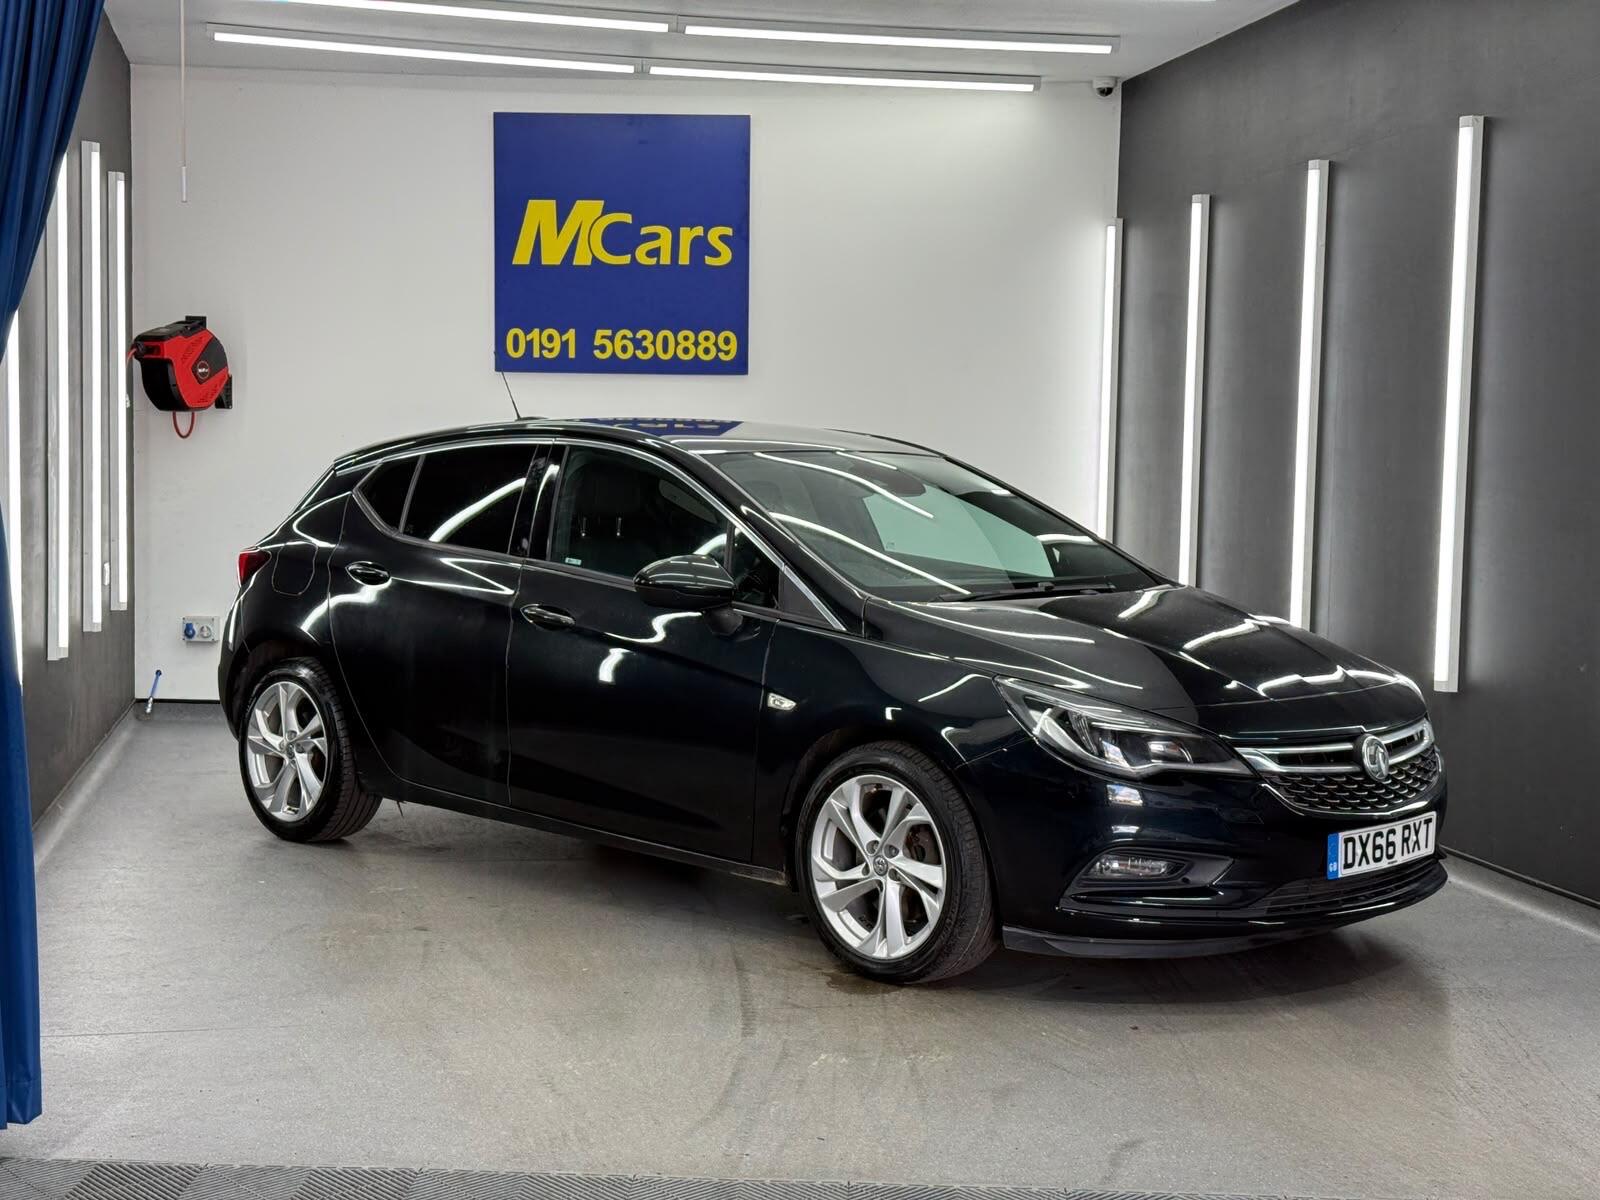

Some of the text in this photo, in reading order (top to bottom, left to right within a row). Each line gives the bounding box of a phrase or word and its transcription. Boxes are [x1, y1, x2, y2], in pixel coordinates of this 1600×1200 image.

[506, 328, 738, 361] 0191 5630889
[1343, 818, 1433, 869] DX66 RXT
